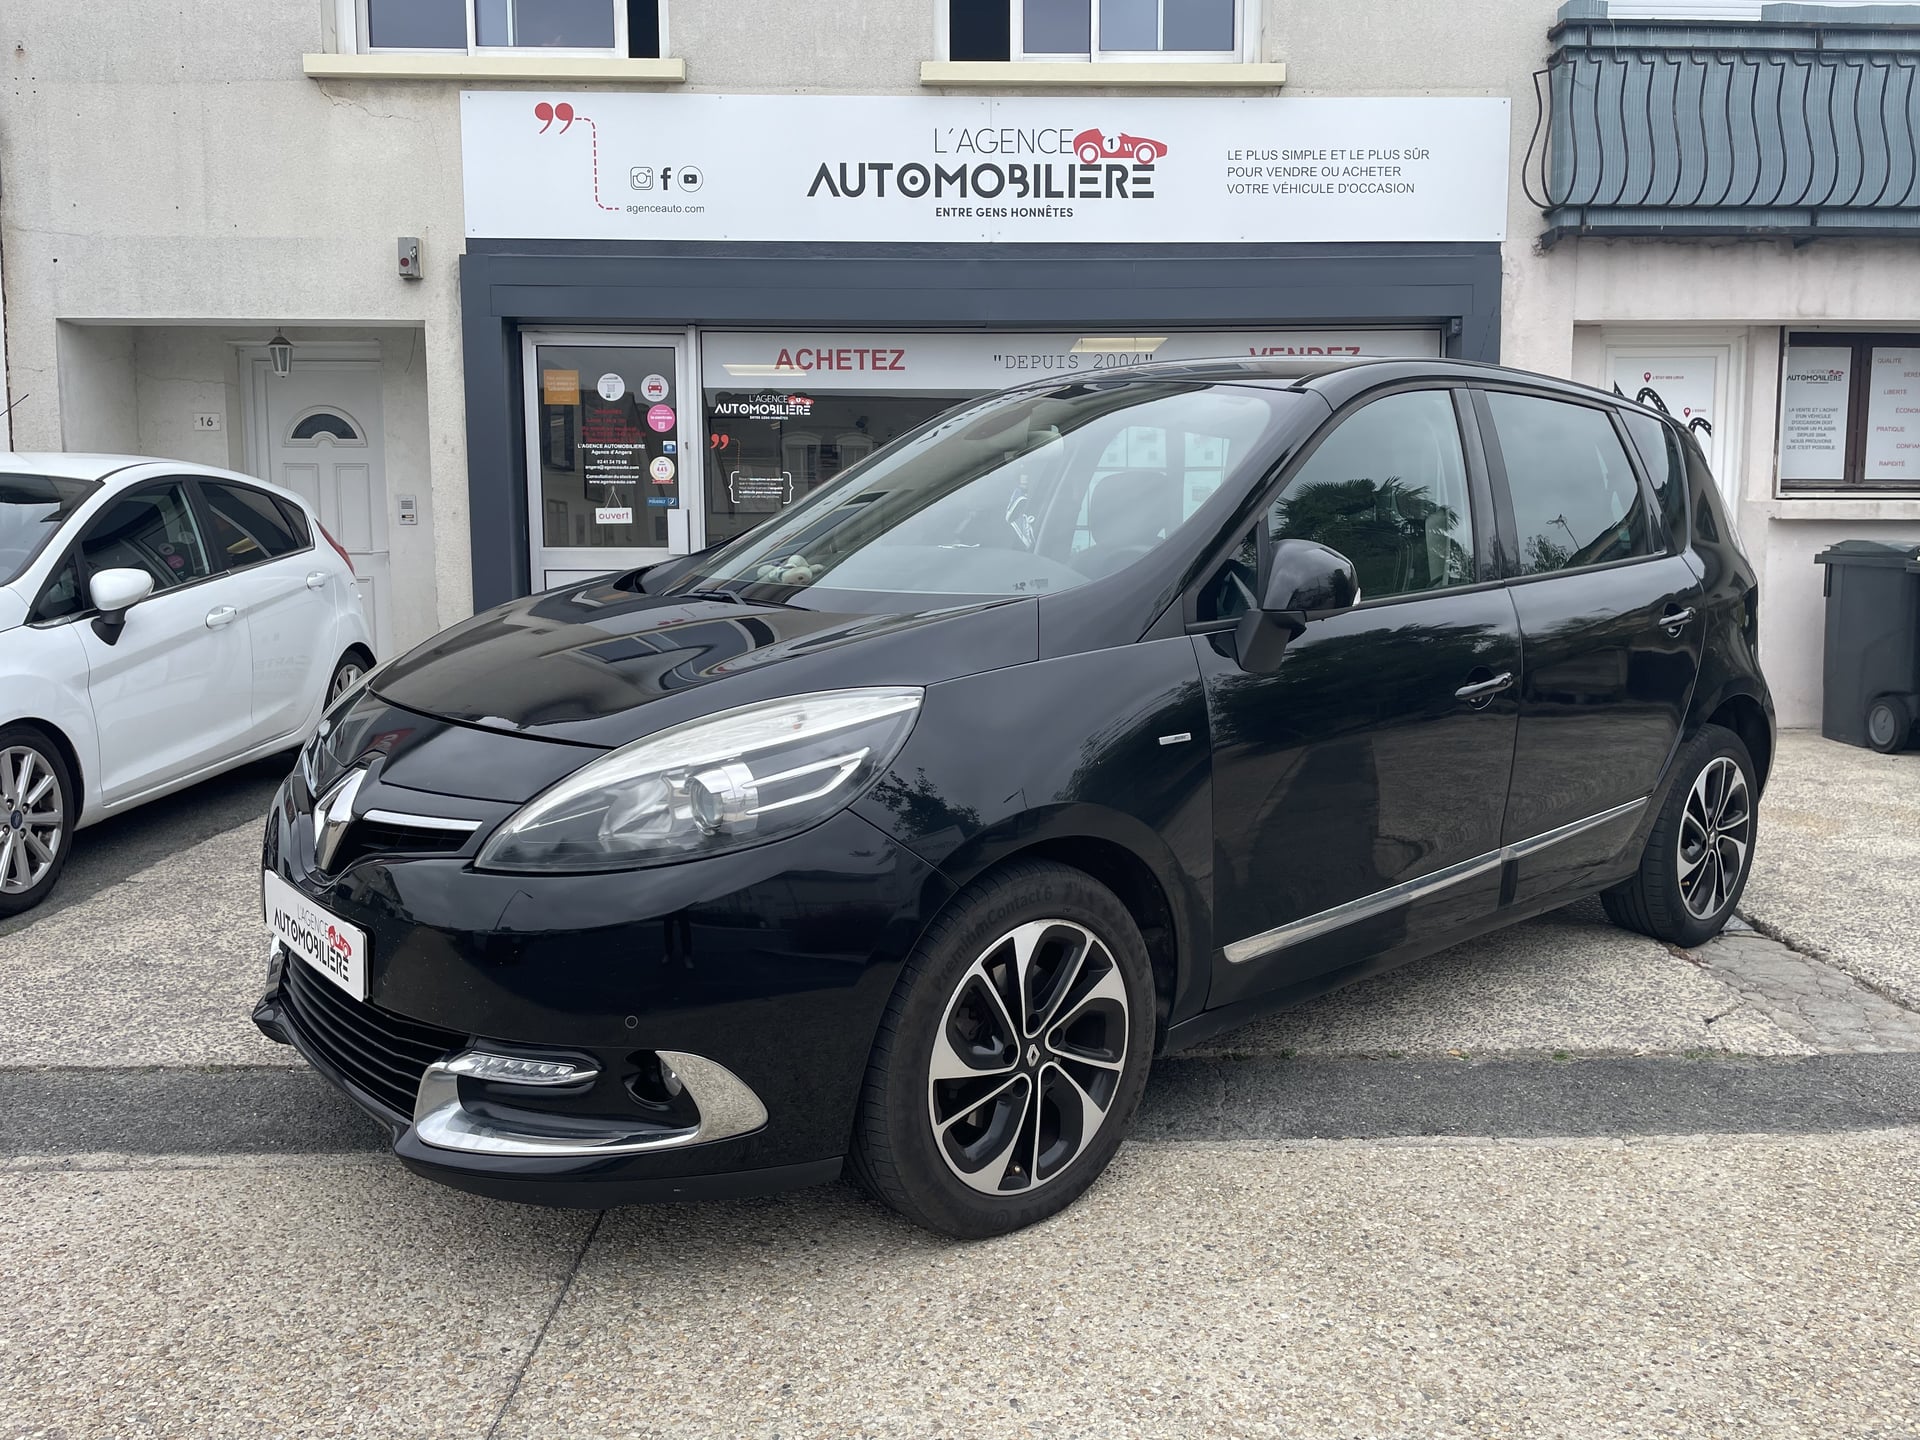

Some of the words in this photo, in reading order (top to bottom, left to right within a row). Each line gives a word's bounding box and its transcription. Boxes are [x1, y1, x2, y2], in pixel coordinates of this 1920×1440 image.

[934, 127, 1074, 154] L'AGENCE
[1227, 150, 1243, 160] LE
[1246, 150, 1278, 160] PLUS
[1281, 150, 1327, 160] SIMPLE
[1330, 150, 1346, 160] ET
[1349, 149, 1364, 160] LE
[1368, 149, 1400, 160] PLUS
[1403, 147, 1430, 160] SÛR
[1227, 167, 1263, 177] POUR
[1266, 167, 1318, 177] VENDRE
[1321, 167, 1340, 177] OU
[1342, 166, 1401, 177] ACHETER
[1226, 183, 1269, 194] VOTRE
[1272, 181, 1334, 194] VÉHICULE
[1338, 183, 1415, 194] D'OCCASION
[626, 205, 705, 215] agenceauto.com
[935, 207, 973, 217] ENTRE
[976, 207, 1007, 217] GENS
[1011, 204, 1074, 217] HONNÊTES
[774, 348, 906, 371] ACHETEZ
[200, 416, 214, 427] 16
[598, 511, 629, 520] ouvert
